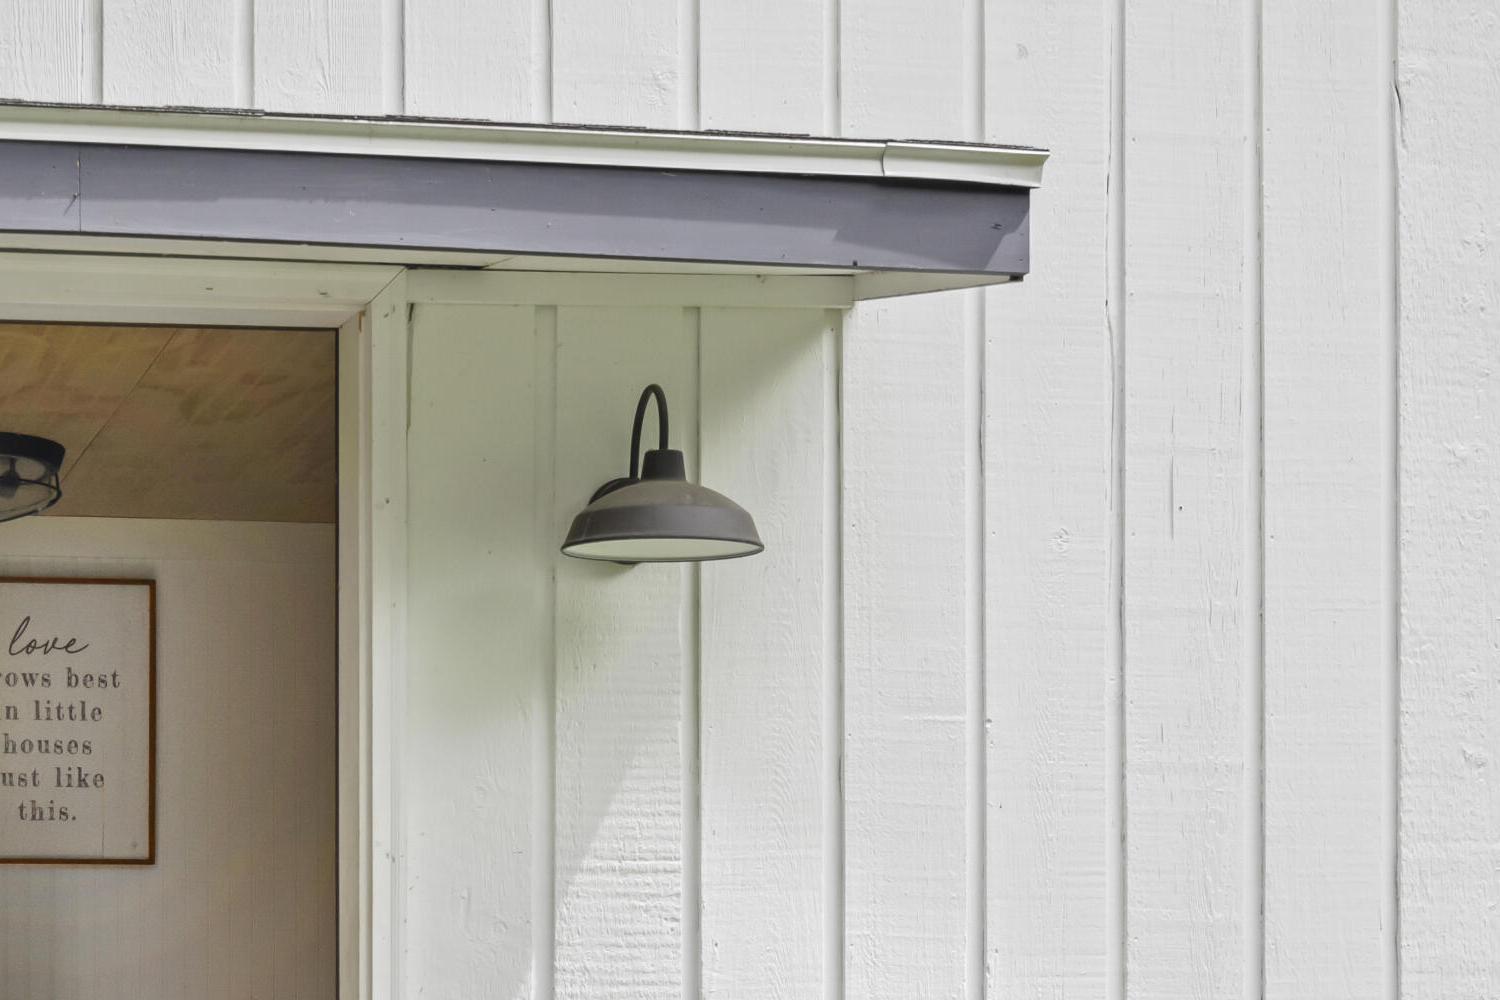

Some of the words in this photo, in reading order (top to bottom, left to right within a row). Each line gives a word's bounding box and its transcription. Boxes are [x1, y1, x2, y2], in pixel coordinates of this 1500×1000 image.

[8, 615, 89, 656] love
[66, 667, 120, 688] best
[34, 700, 102, 721] little
[3, 733, 92, 754] houses
[55, 767, 105, 788] like
[19, 800, 76, 821] this.
